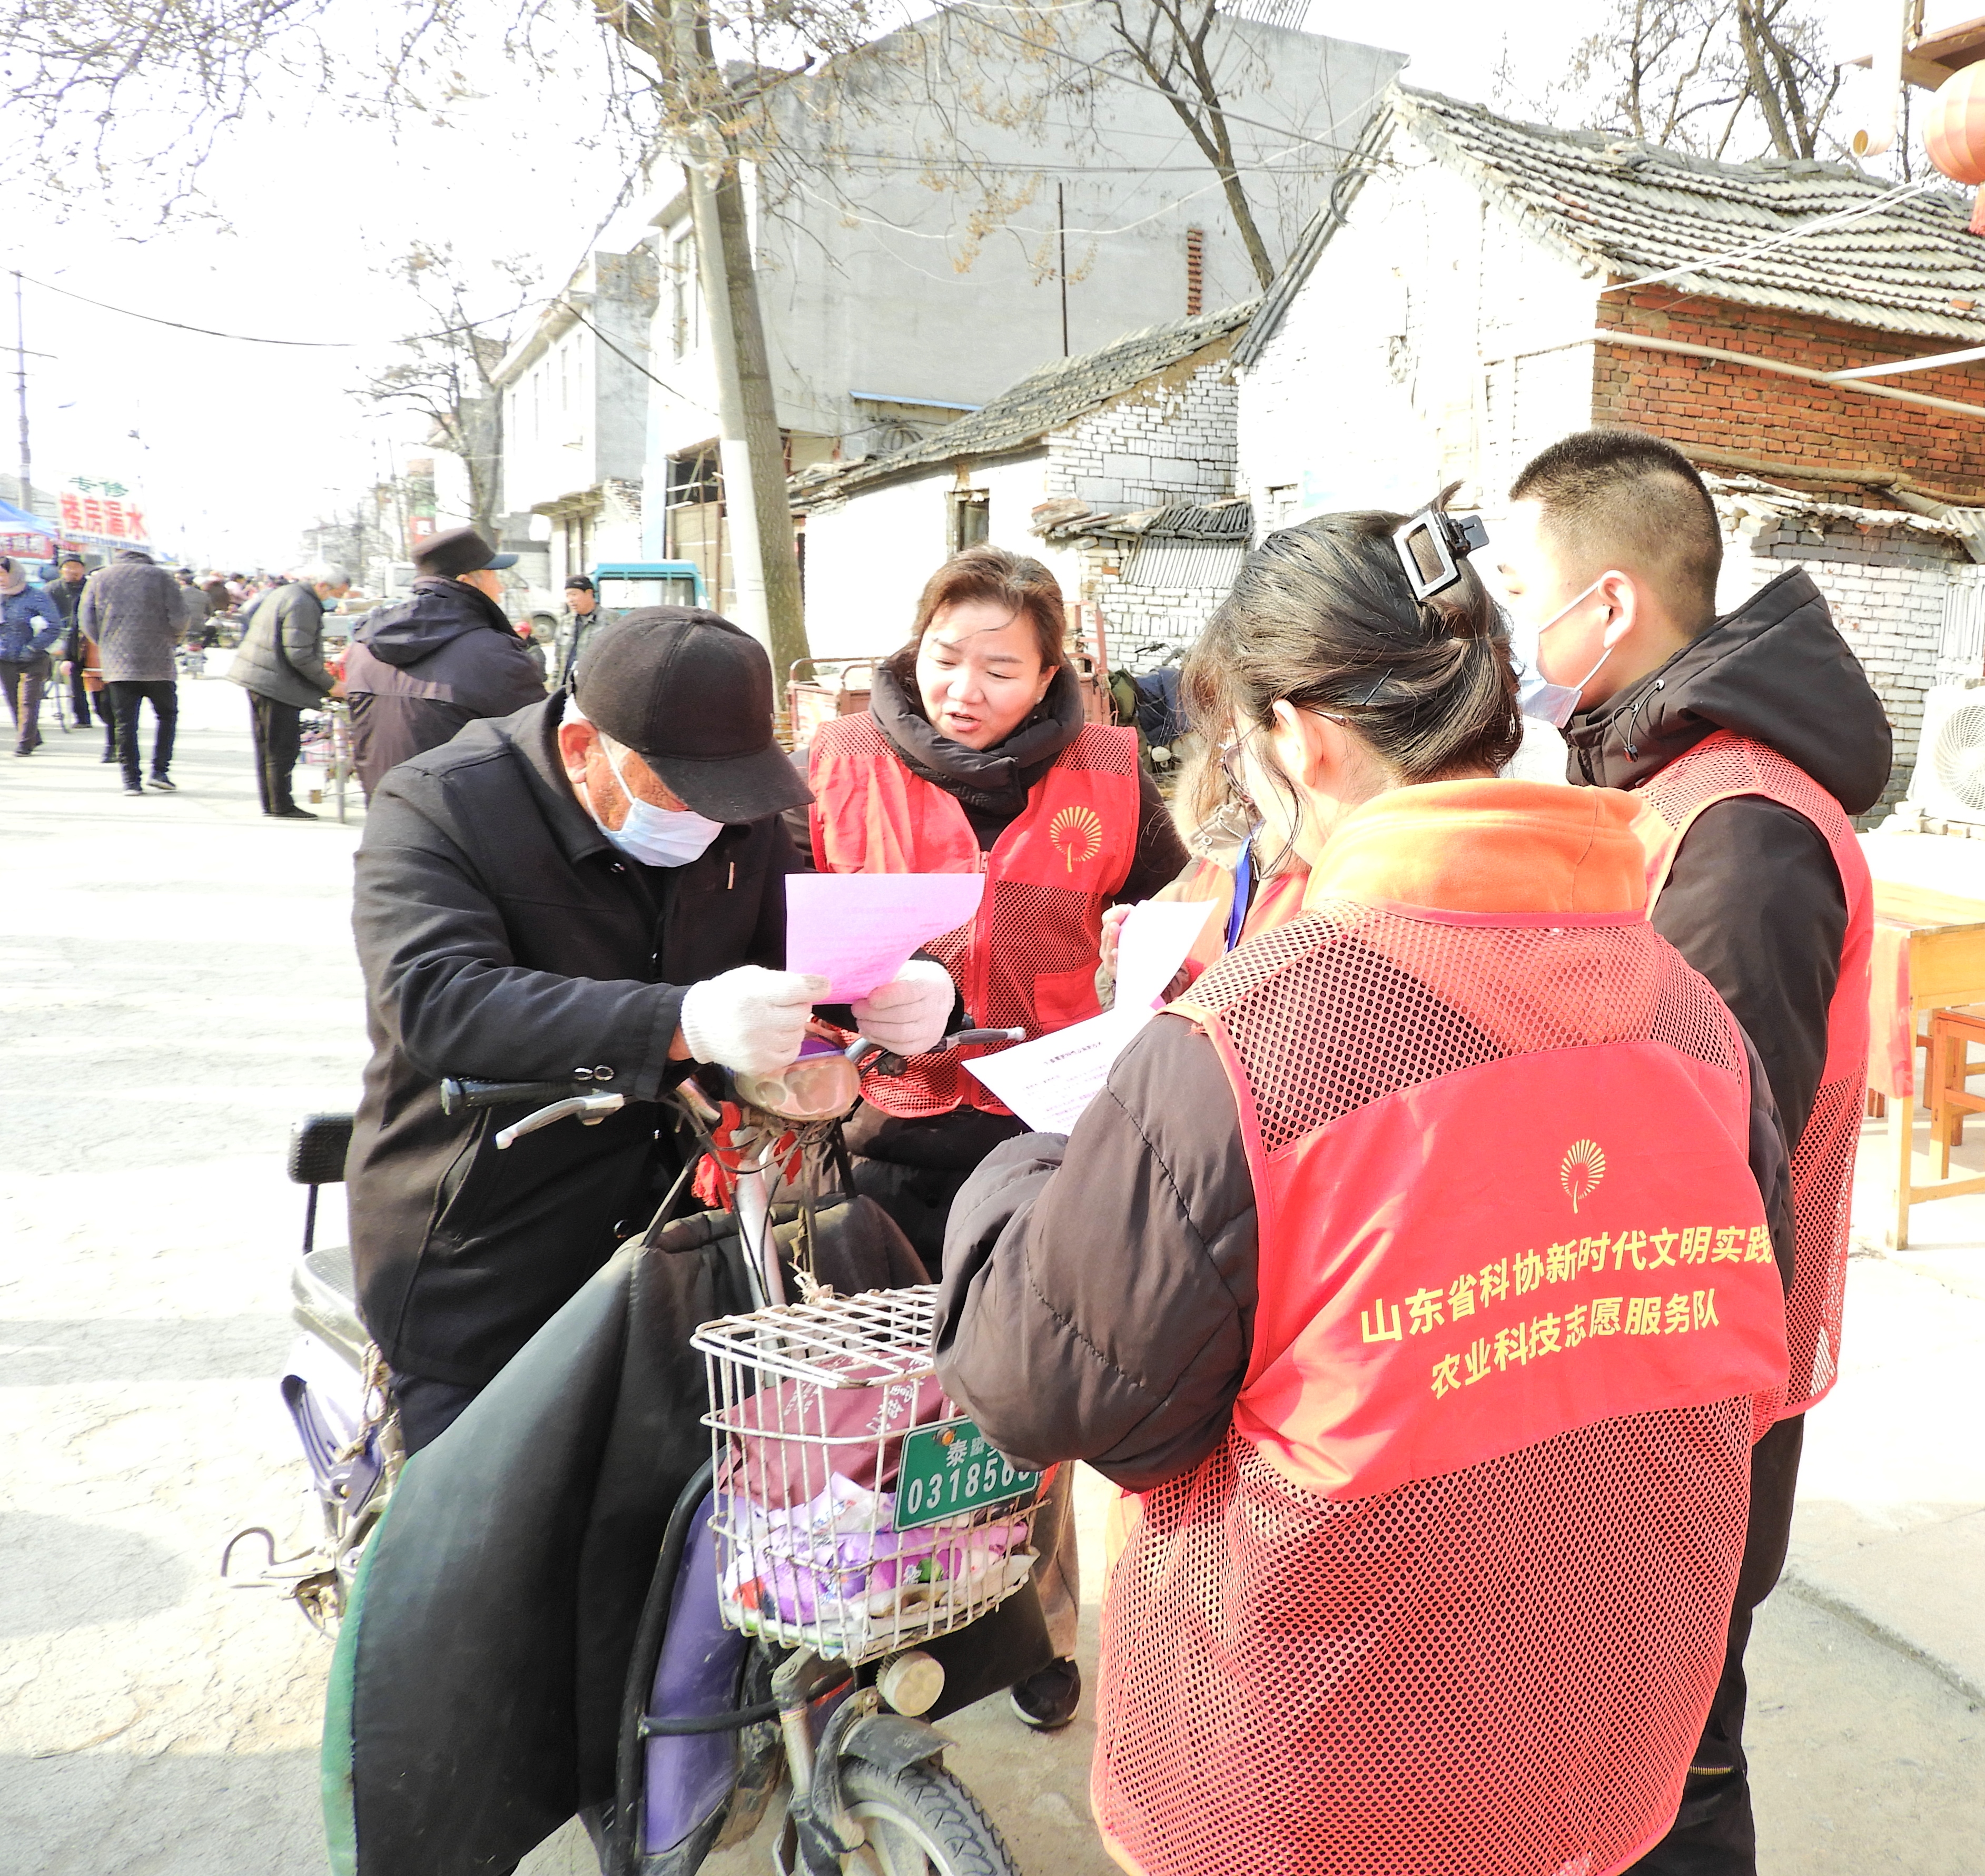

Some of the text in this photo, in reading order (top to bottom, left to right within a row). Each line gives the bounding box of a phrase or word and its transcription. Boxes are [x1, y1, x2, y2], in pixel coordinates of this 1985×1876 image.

[60, 491, 147, 540] 楼房漏水
[1360, 1224, 1772, 1344] 山东省科协新时代文明实践
[1430, 1288, 1720, 1400] 农业科技志愿服务队
